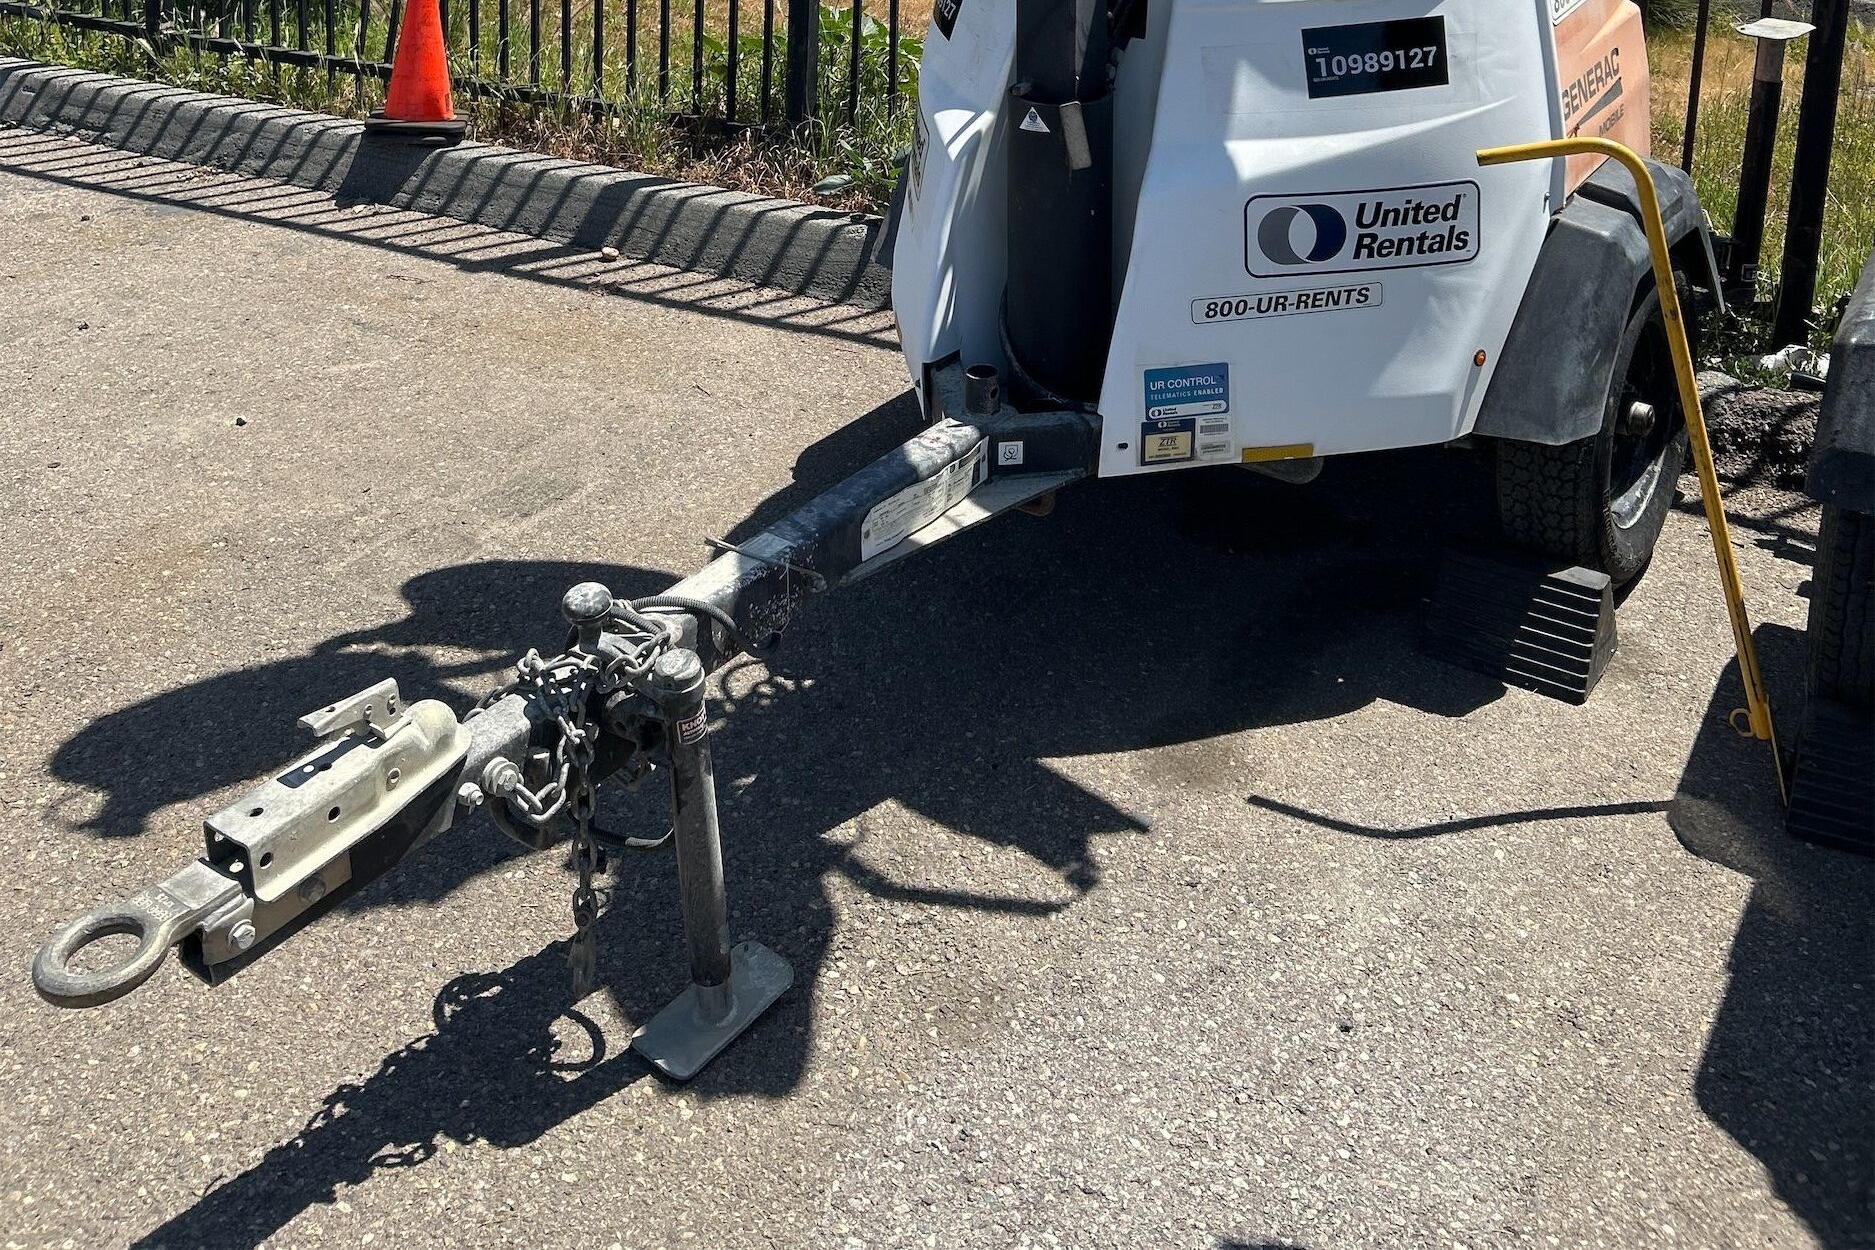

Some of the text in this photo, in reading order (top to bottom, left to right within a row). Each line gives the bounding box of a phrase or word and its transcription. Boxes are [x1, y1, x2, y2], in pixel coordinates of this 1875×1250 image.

[1315, 46, 1438, 77] 10989127
[1562, 47, 1620, 122] GENERAC
[1355, 194, 1463, 229] United
[1353, 225, 1470, 260] Rentals
[1204, 286, 1370, 319] 800-UR-RENTS
[1150, 376, 1217, 391] UR CONTROL
[1150, 388, 1223, 400] TELEMATICS ENABLED
